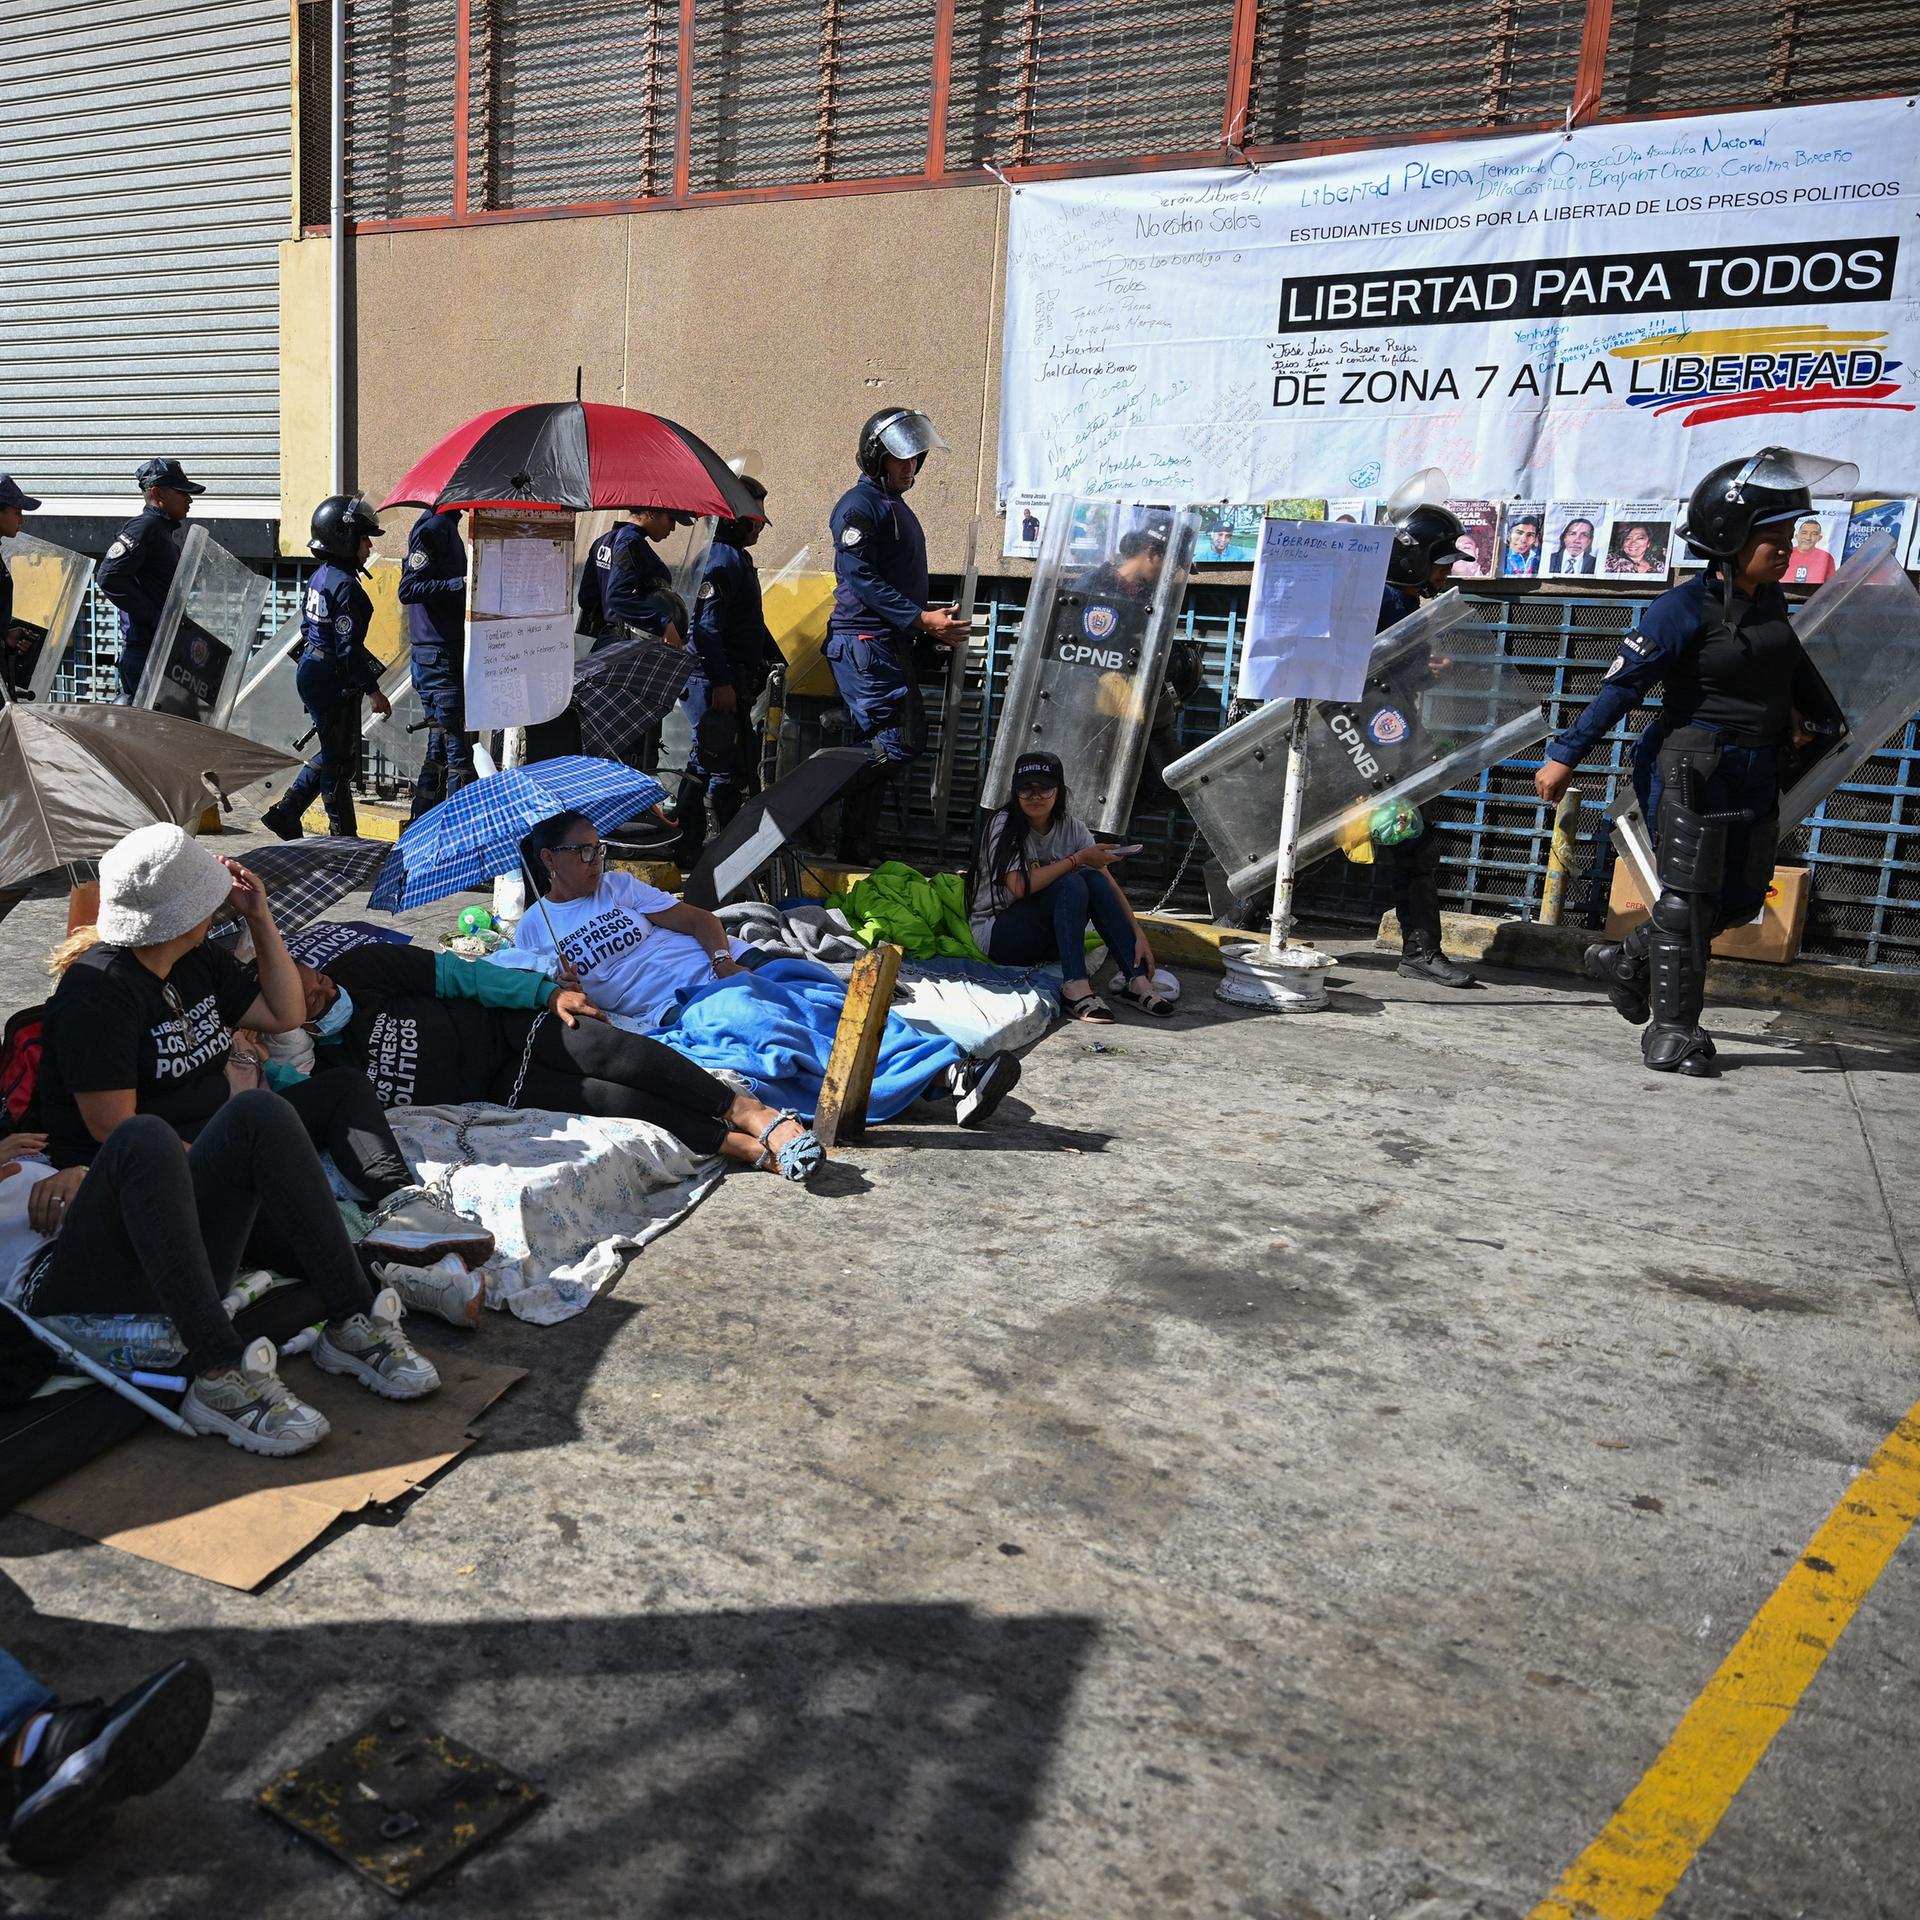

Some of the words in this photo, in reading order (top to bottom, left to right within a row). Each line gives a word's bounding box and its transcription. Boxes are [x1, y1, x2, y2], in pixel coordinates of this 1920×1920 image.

[1702, 126, 1768, 156] Nacional
[1721, 155, 1789, 177] Carolina
[1795, 149, 1852, 168] Briceño
[1210, 206, 1262, 232] Solos
[1290, 221, 1402, 242] ESTUDIANTES
[1407, 215, 1471, 233] UNIDOS
[1475, 211, 1512, 227] POR
[1517, 209, 1539, 224] LA
[1543, 202, 1631, 222] LIBERTAD
[1635, 200, 1661, 215] DE
[1666, 196, 1702, 213] LOS
[1707, 189, 1788, 209] PRESOS
[1793, 181, 1900, 203] POLITICOS
[1289, 273, 1518, 322] LIBERTAD
[1532, 263, 1671, 307] PARA
[1688, 249, 1884, 298] TODOS
[1273, 373, 1327, 407] DE
[1339, 368, 1460, 404] ZONA
[1475, 365, 1499, 399] 7
[1508, 364, 1540, 397] A
[1555, 360, 1613, 396] LA
[1629, 350, 1882, 393] LIBERTAD
[1059, 643, 1124, 670] CPNB
[171, 664, 209, 698] CPNB
[1330, 714, 1380, 779] CPNB
[301, 927, 358, 969] UTIVOS
[555, 925, 588, 956] BEREN
[589, 920, 597, 928] A
[564, 942, 584, 964] OS
[583, 915, 634, 950] PRESOS
[575, 926, 642, 977] OLÍTICOS
[186, 995, 216, 1020] ODOS
[156, 1035, 187, 1054] LOS
[194, 1009, 221, 1044] ESOS
[368, 1012, 387, 1045] TODOS
[368, 1048, 378, 1057] A
[394, 1018, 418, 1106] OLÍTICOS
[375, 1080, 393, 1106] OS
